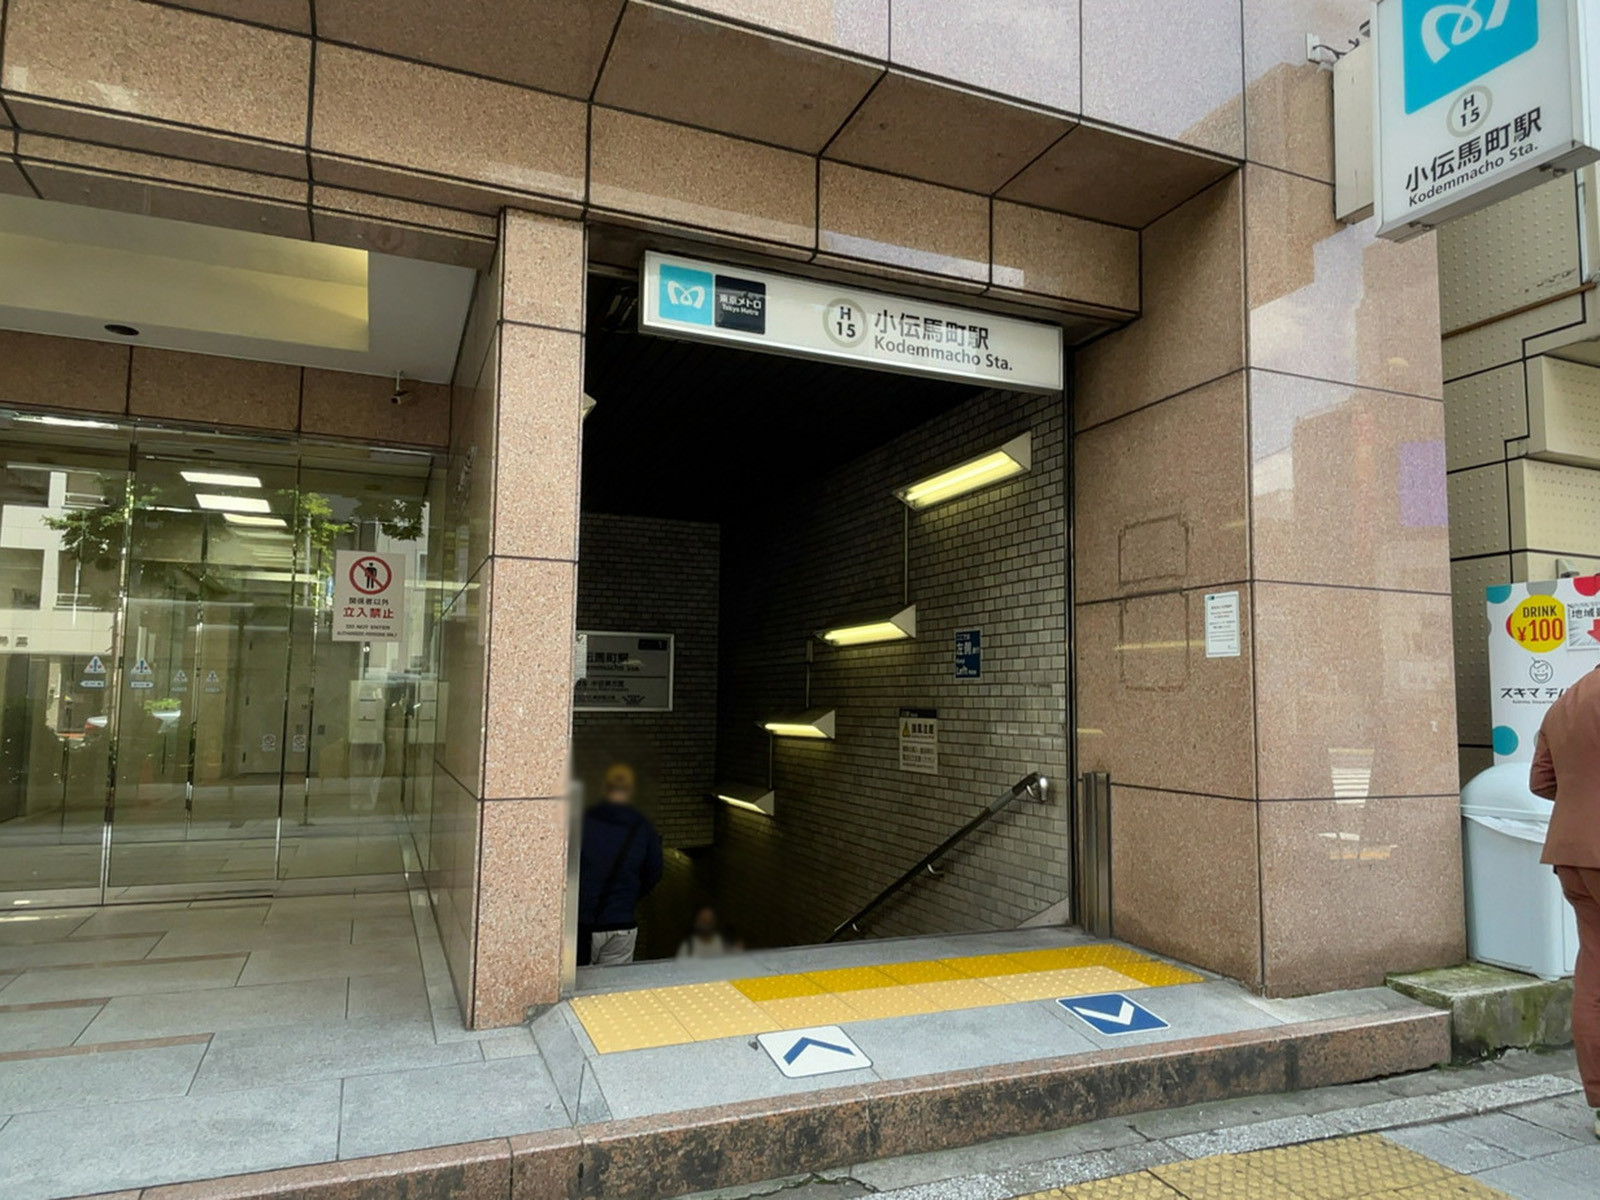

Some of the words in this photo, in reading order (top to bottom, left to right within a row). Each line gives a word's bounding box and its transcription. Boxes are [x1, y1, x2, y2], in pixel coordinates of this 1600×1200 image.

[1463, 94, 1475, 111] H
[1460, 107, 1481, 127] 15
[1405, 107, 1542, 192] 小伝馬町駅
[1409, 155, 1504, 207] Kodemmacho
[1509, 142, 1539, 162] Sta.
[719, 293, 762, 309] 東京メトロ
[722, 302, 740, 313] Tokyo
[740, 306, 759, 316] Metro
[840, 306, 852, 321] H
[835, 321, 856, 339] 15
[873, 309, 990, 351] 小伝馬町駅
[873, 335, 981, 366] Kodemmacho
[985, 353, 1013, 371] Sta.
[344, 607, 393, 618] 立入禁止
[1523, 605, 1557, 618] DRINK
[1517, 618, 1564, 642] ¥100
[1501, 688, 1540, 698] スキマ
